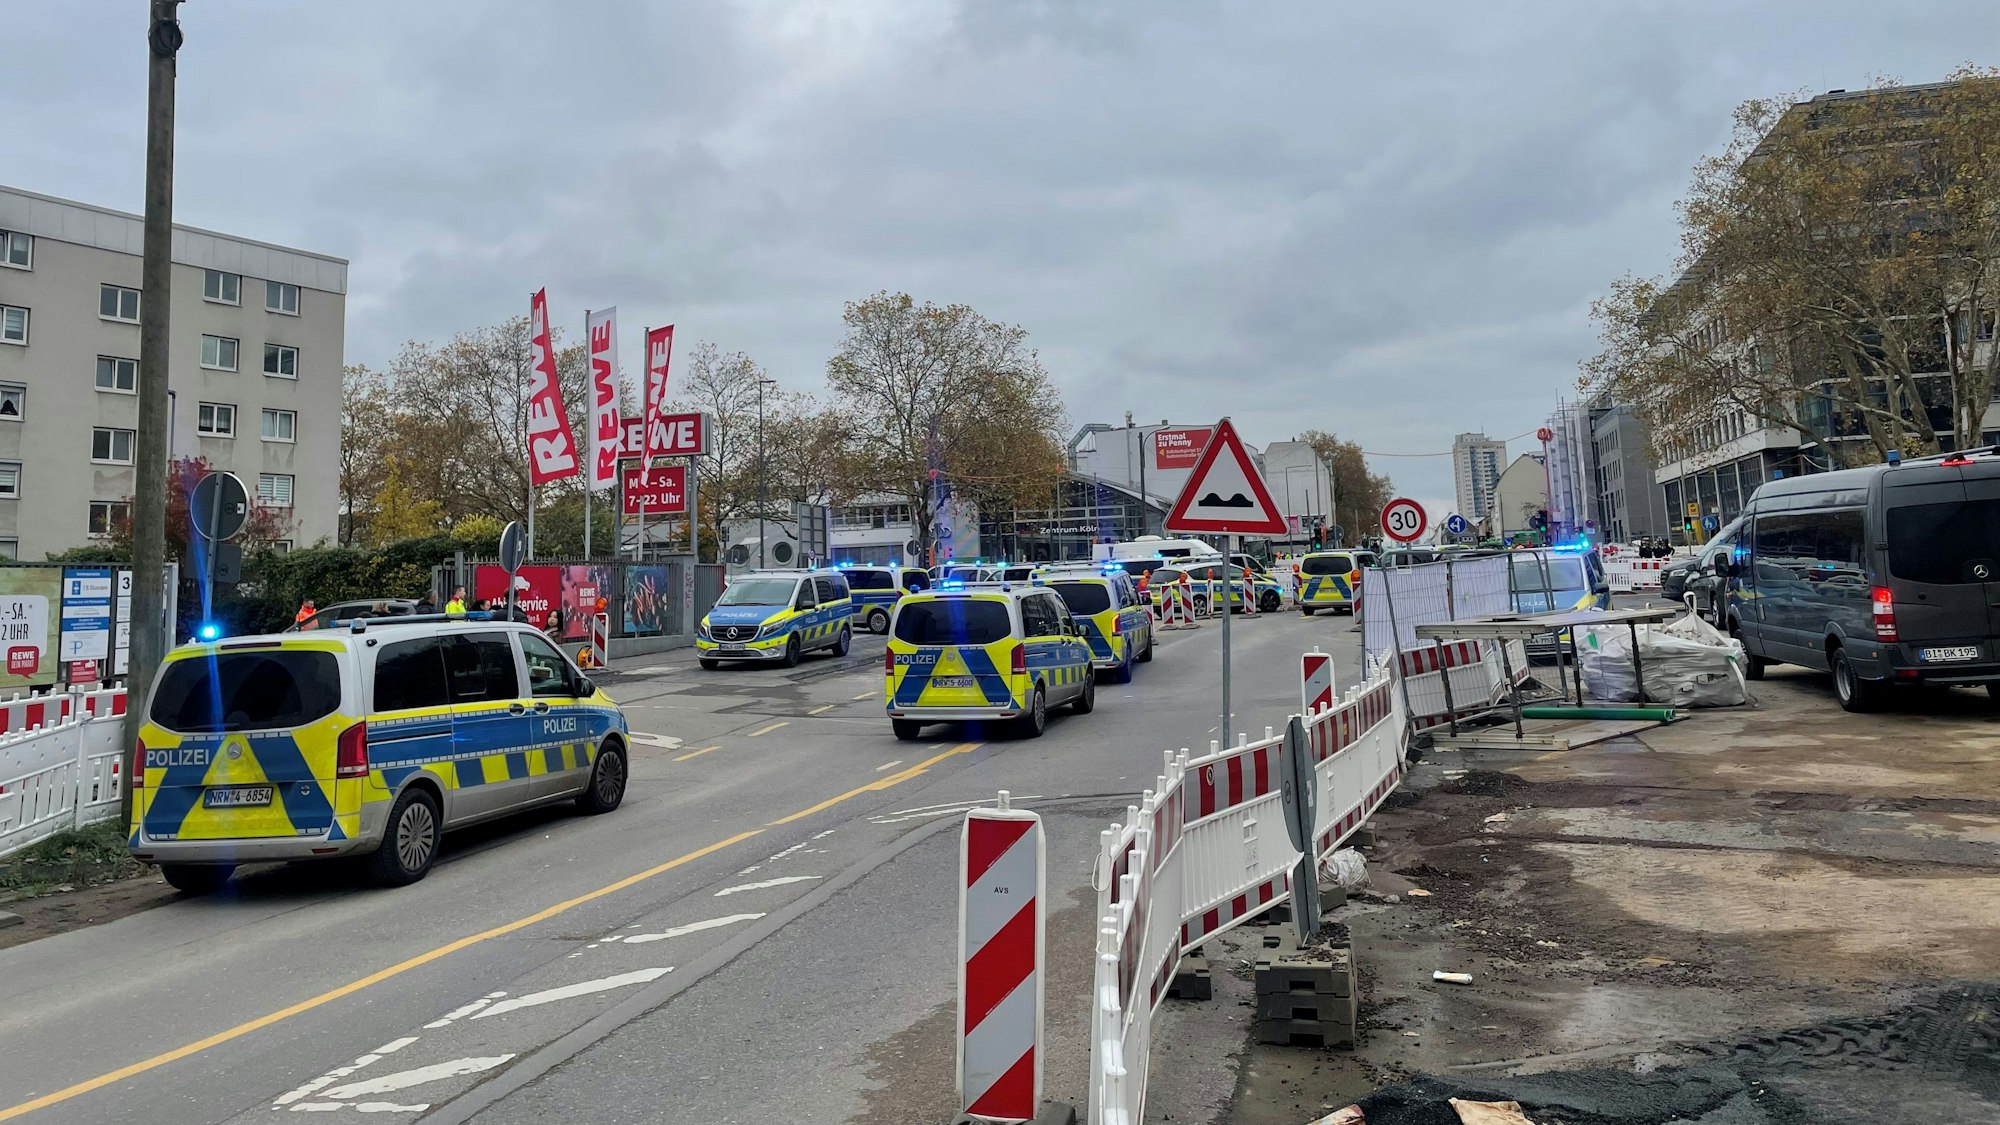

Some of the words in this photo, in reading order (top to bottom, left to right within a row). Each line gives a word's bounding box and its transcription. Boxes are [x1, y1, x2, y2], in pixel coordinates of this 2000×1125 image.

[529, 301, 575, 475] REWE
[592, 319, 618, 481] REWE
[1158, 432, 1186, 441] Erstmal
[1168, 439, 1192, 447] Penny
[629, 478, 648, 489] M.
[659, 476, 676, 488] Sa.
[661, 492, 681, 505] Uhr
[1390, 510, 1417, 531] 30
[580, 587, 595, 597] REWE
[10, 623, 29, 641] UHR
[11, 651, 35, 660] REWE
[1925, 649, 1937, 658] BI
[1943, 649, 1957, 658] BK
[1958, 647, 1976, 657] 195
[895, 654, 936, 665] POLIZEI
[543, 717, 577, 734] POLIZEI
[146, 749, 209, 767] POLIZEI
[211, 789, 231, 804] NRW
[235, 788, 270, 803] 4-6854
[993, 886, 1009, 894] AVS
